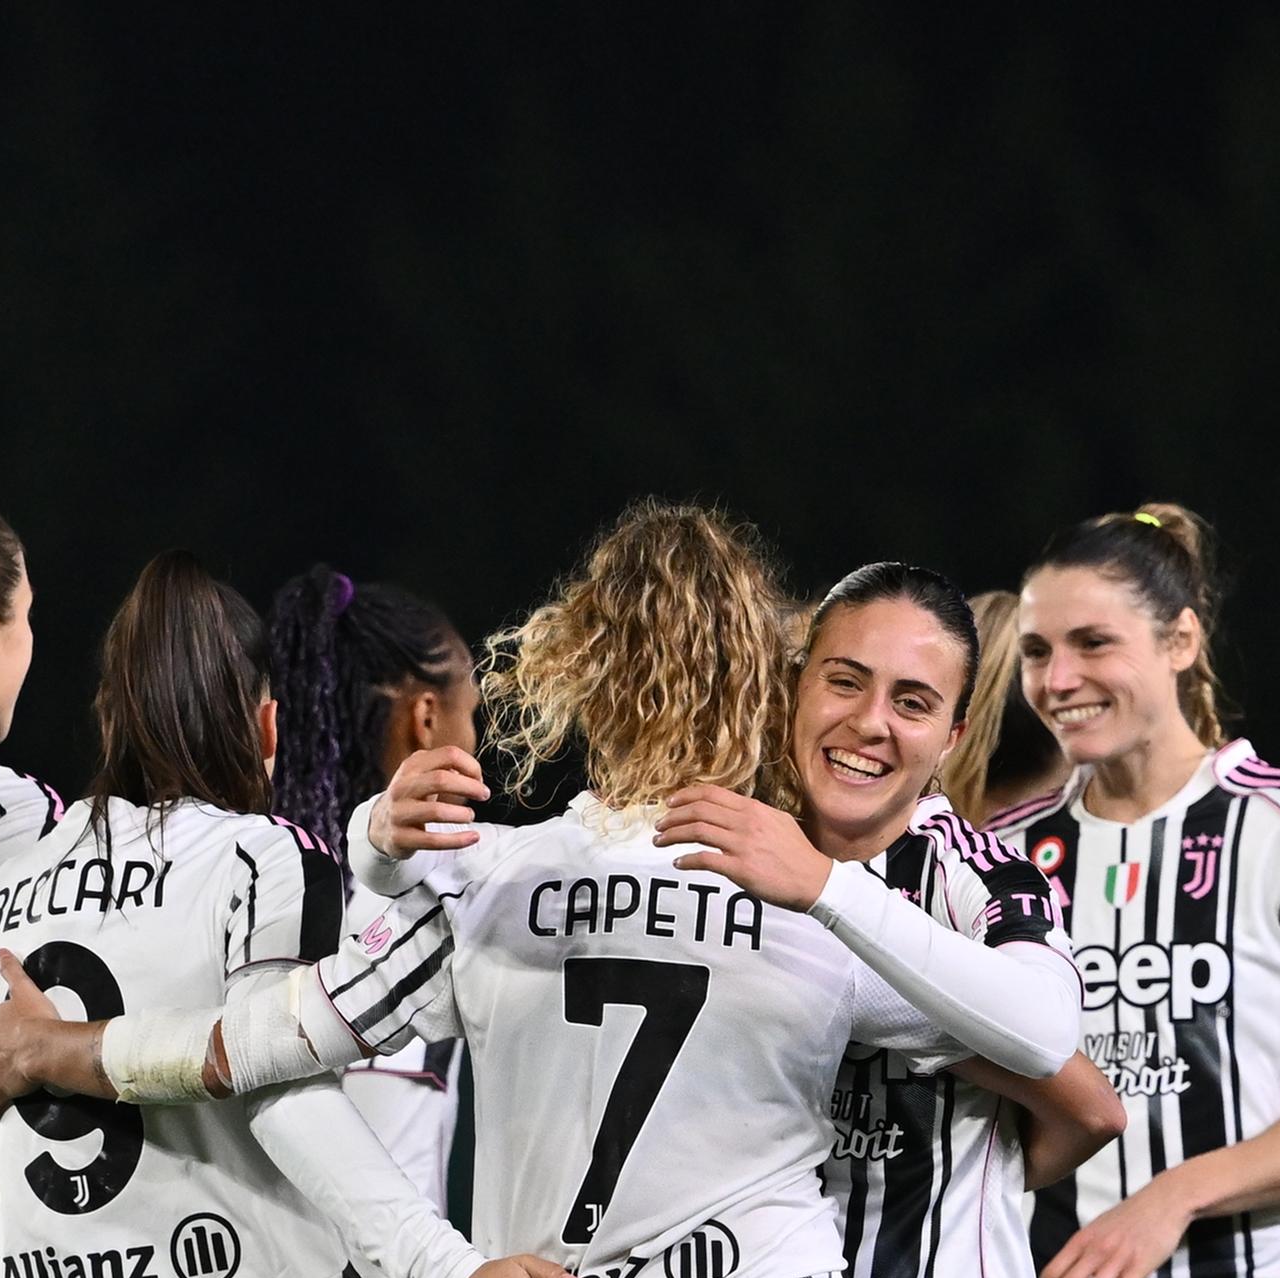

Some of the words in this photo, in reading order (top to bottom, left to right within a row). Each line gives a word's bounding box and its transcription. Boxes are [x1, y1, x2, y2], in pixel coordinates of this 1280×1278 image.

[528, 874, 764, 951] CAPETA
[1073, 942, 1232, 1022] eep
[14, 941, 144, 1215] 9
[1084, 1031, 1158, 1064] VISIT
[1102, 1056, 1191, 1096] troit
[563, 957, 711, 1245] 7
